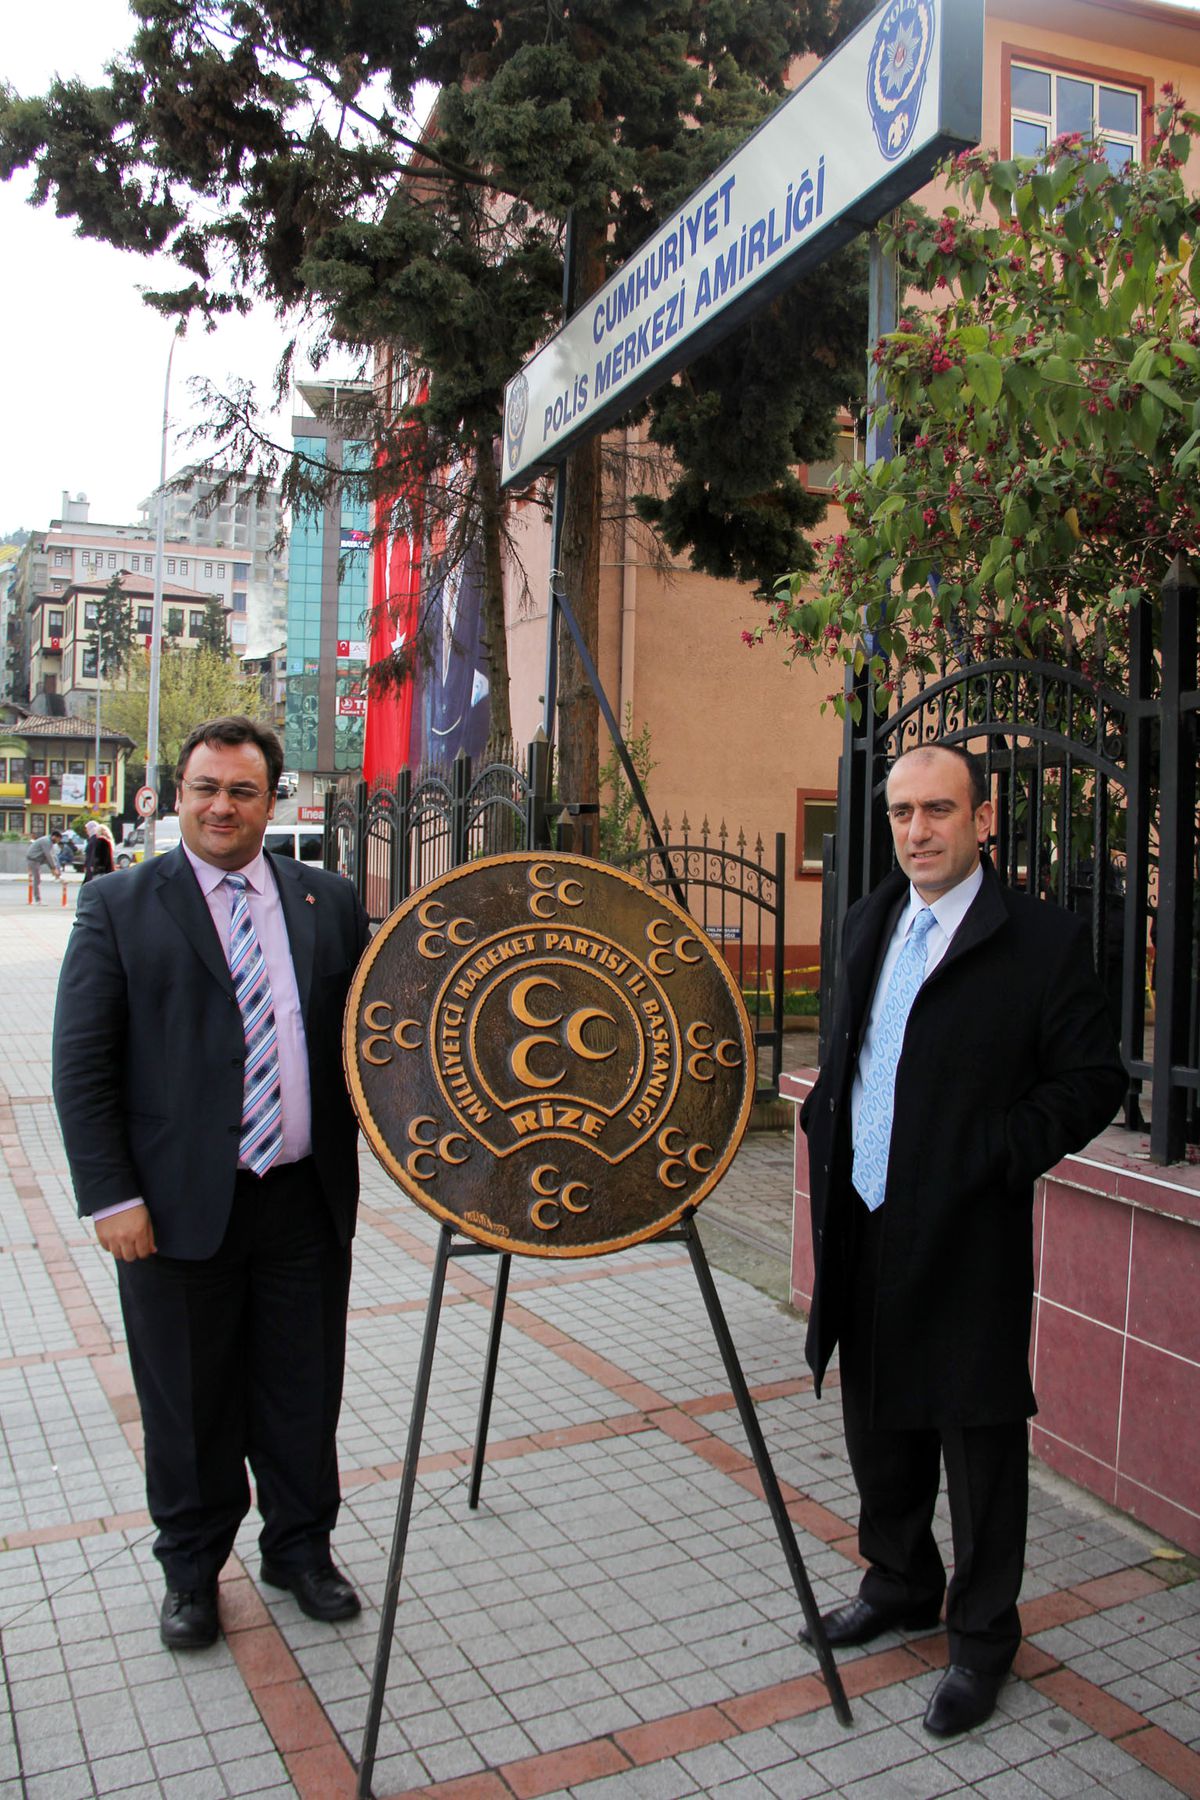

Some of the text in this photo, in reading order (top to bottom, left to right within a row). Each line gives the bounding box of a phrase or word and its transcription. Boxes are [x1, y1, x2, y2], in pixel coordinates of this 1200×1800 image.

[543, 154, 825, 442] POLİS MERKEZİ AMİRLİĞİ
[593, 174, 736, 345] CUMHURİYET
[442, 933, 670, 1130] MİLLİYETÇİ HAREKET PARTİSİ İL BAŞKANLIĞI
[510, 1101, 607, 1138] RİZE
